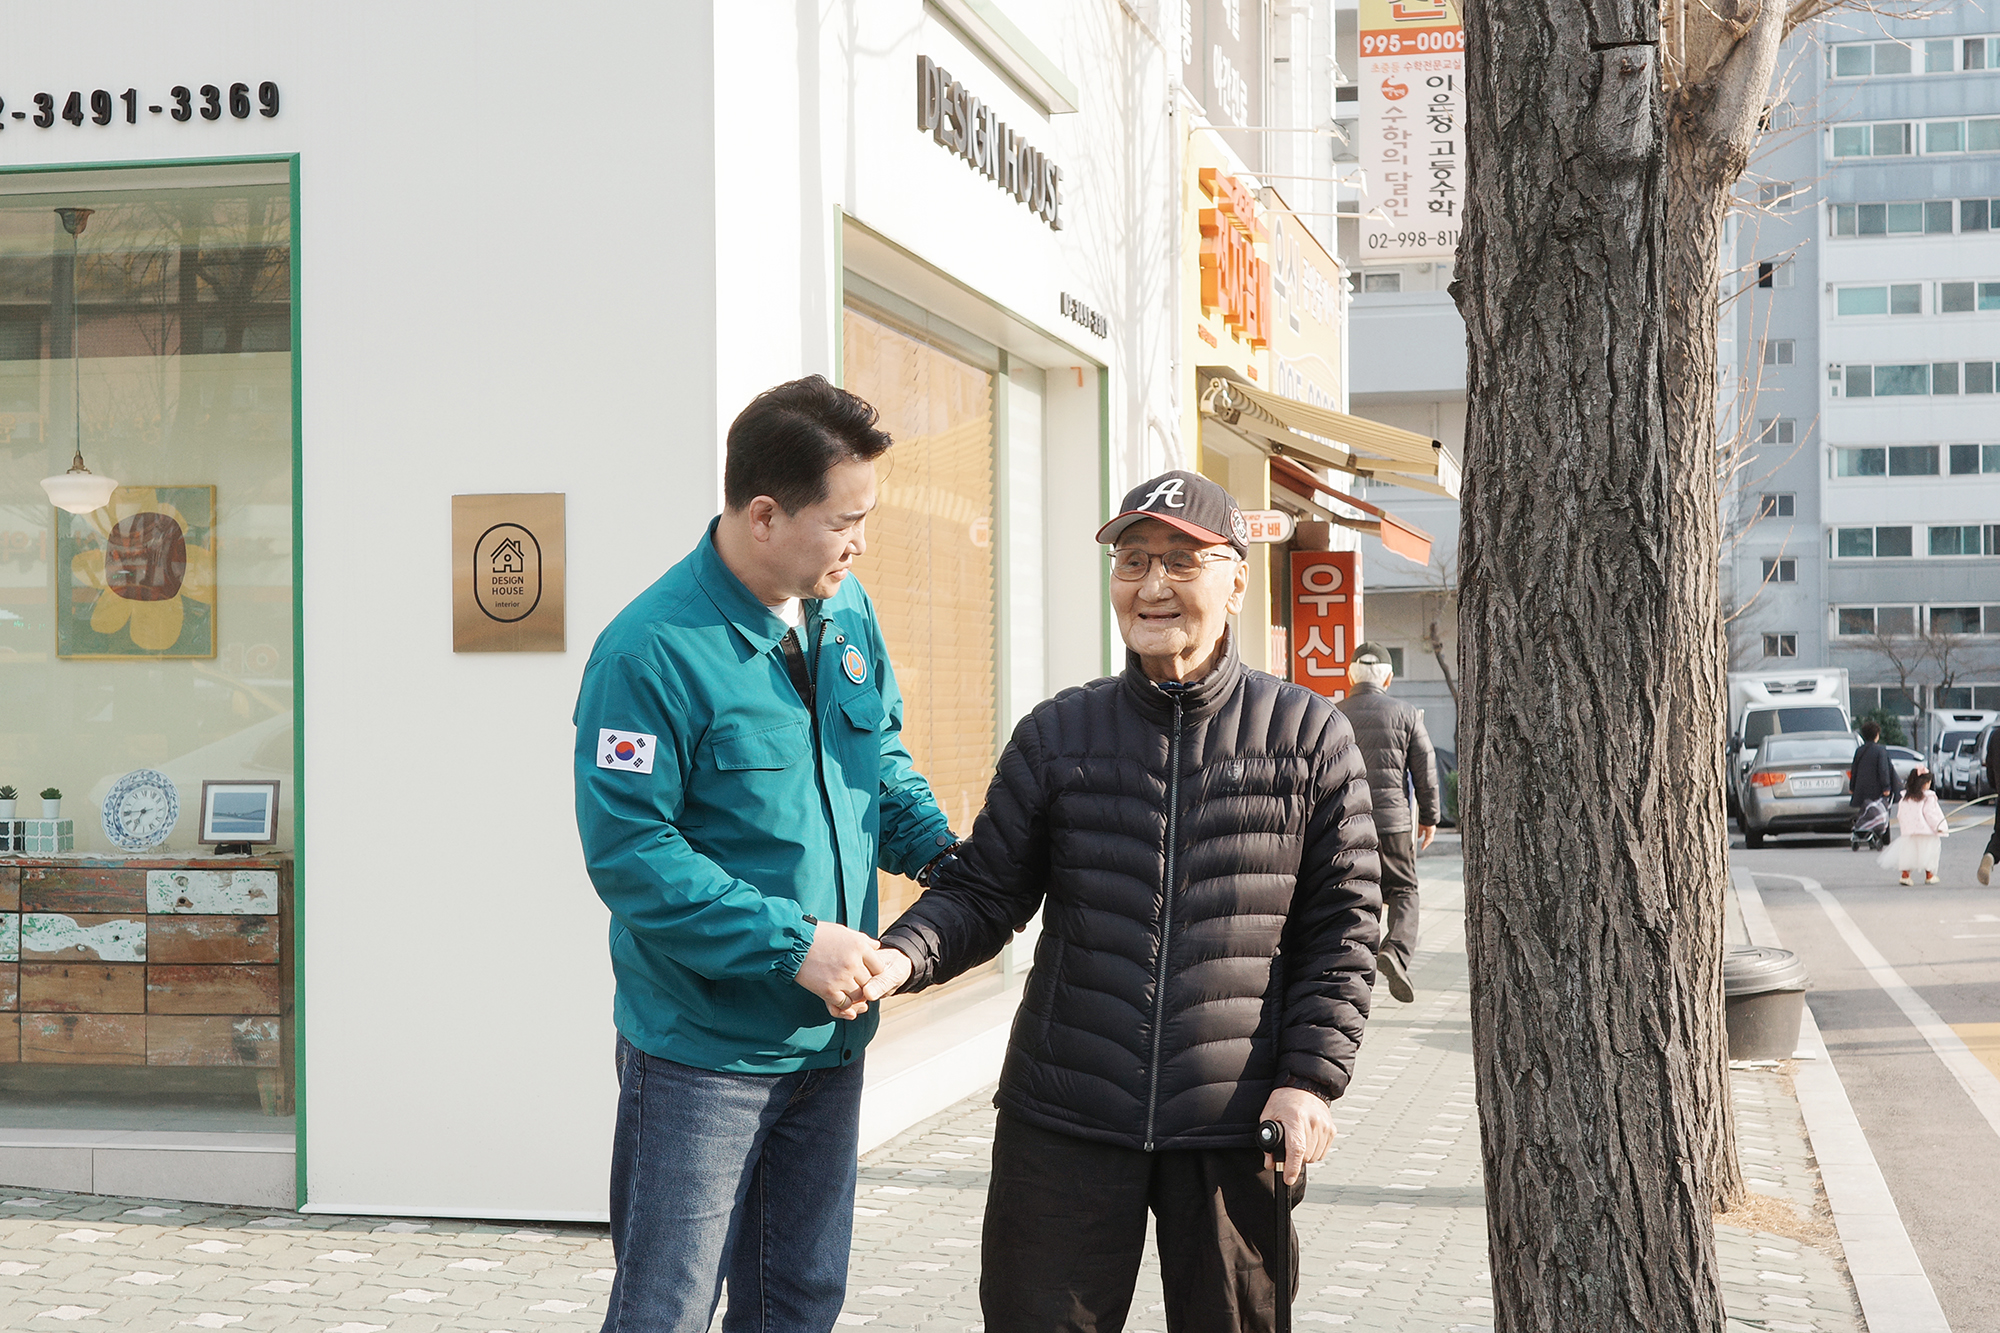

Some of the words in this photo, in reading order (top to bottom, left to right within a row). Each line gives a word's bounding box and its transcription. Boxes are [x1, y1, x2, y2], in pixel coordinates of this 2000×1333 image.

[1362, 30, 1465, 54] 995-0009
[0, 81, 280, 130] -3491-3369
[1426, 74, 1455, 134] 이은정
[916, 53, 999, 182] DESIGN
[998, 121, 1064, 232] HOUSE
[1427, 140, 1457, 217] 고등수학
[1368, 230, 1460, 250] 02-998-811
[1136, 478, 1185, 512] A
[491, 576, 524, 585] DESIGN
[491, 586, 524, 596] HOUSE
[494, 600, 521, 608] interior
